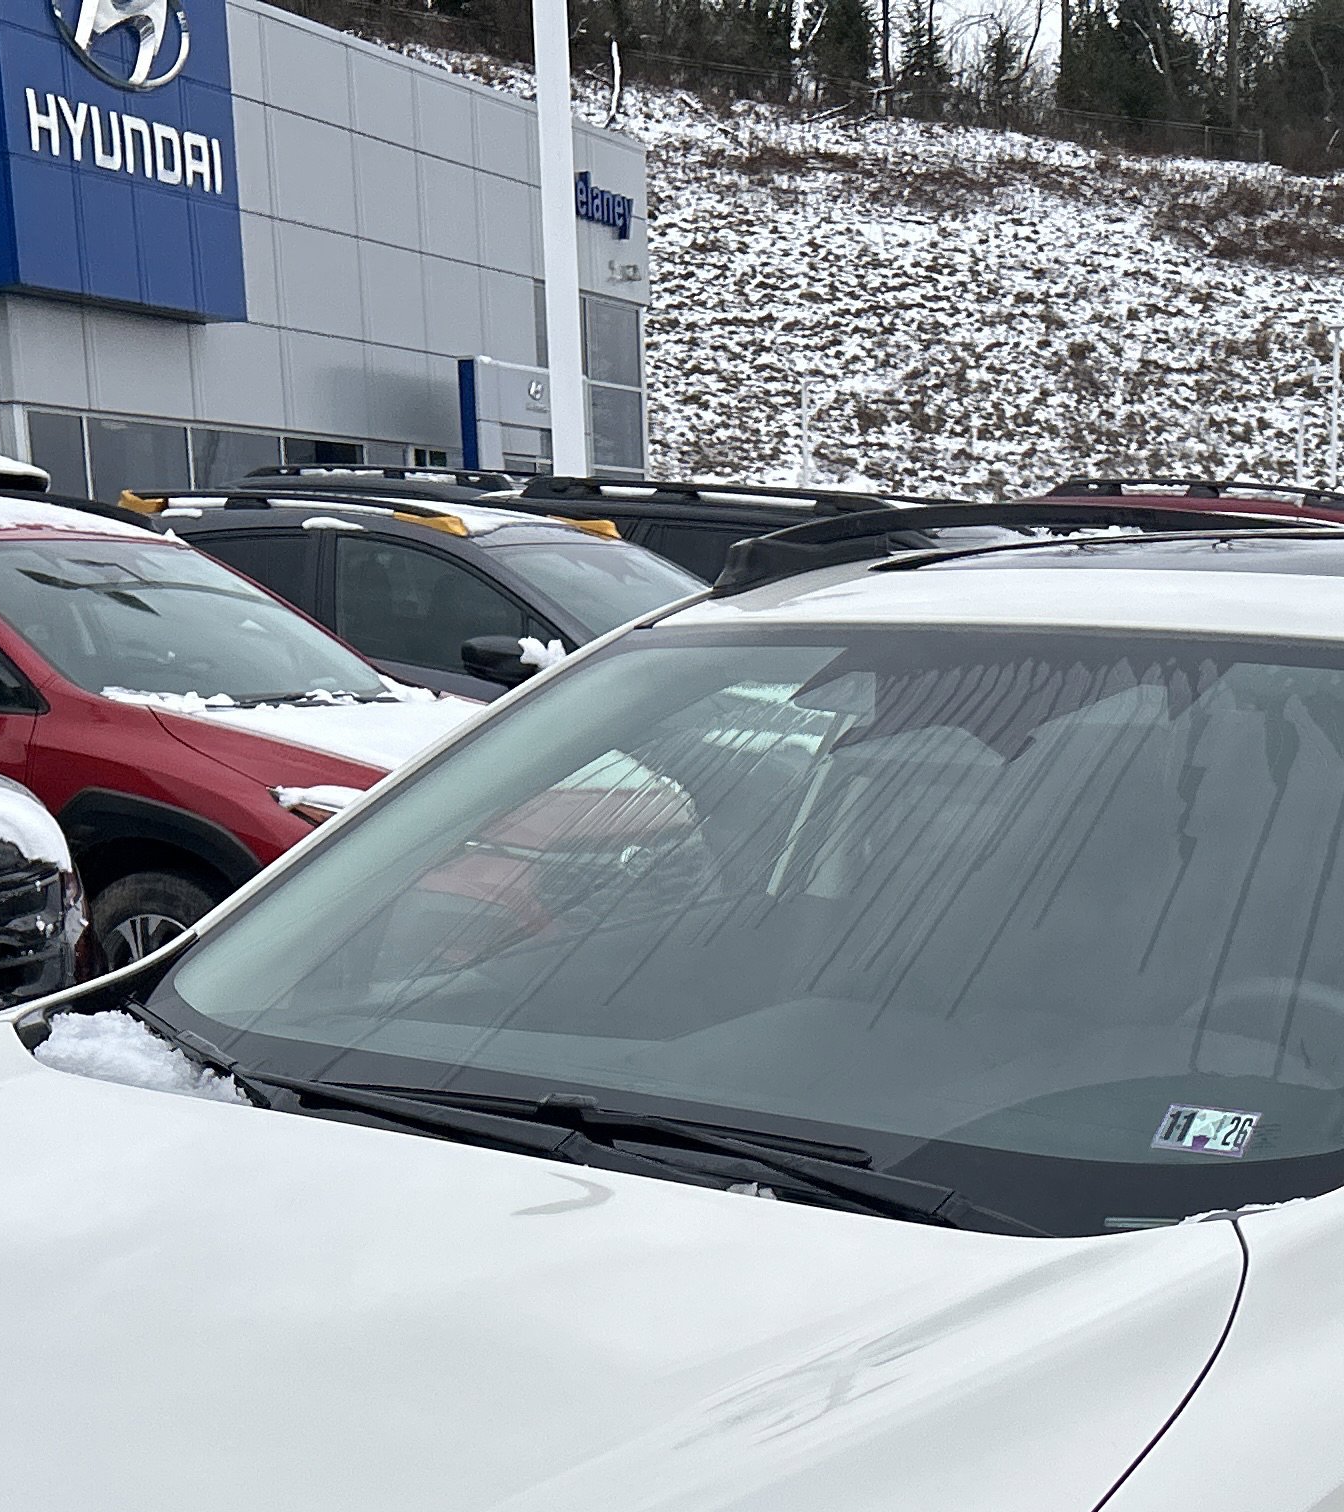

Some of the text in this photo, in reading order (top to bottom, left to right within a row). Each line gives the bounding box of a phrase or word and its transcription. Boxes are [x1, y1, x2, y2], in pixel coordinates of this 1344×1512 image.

[25, 87, 223, 195] HYUNDAI
[574, 171, 633, 240] elaney
[1163, 1110, 1197, 1142] 11
[1221, 1116, 1255, 1149] 26
